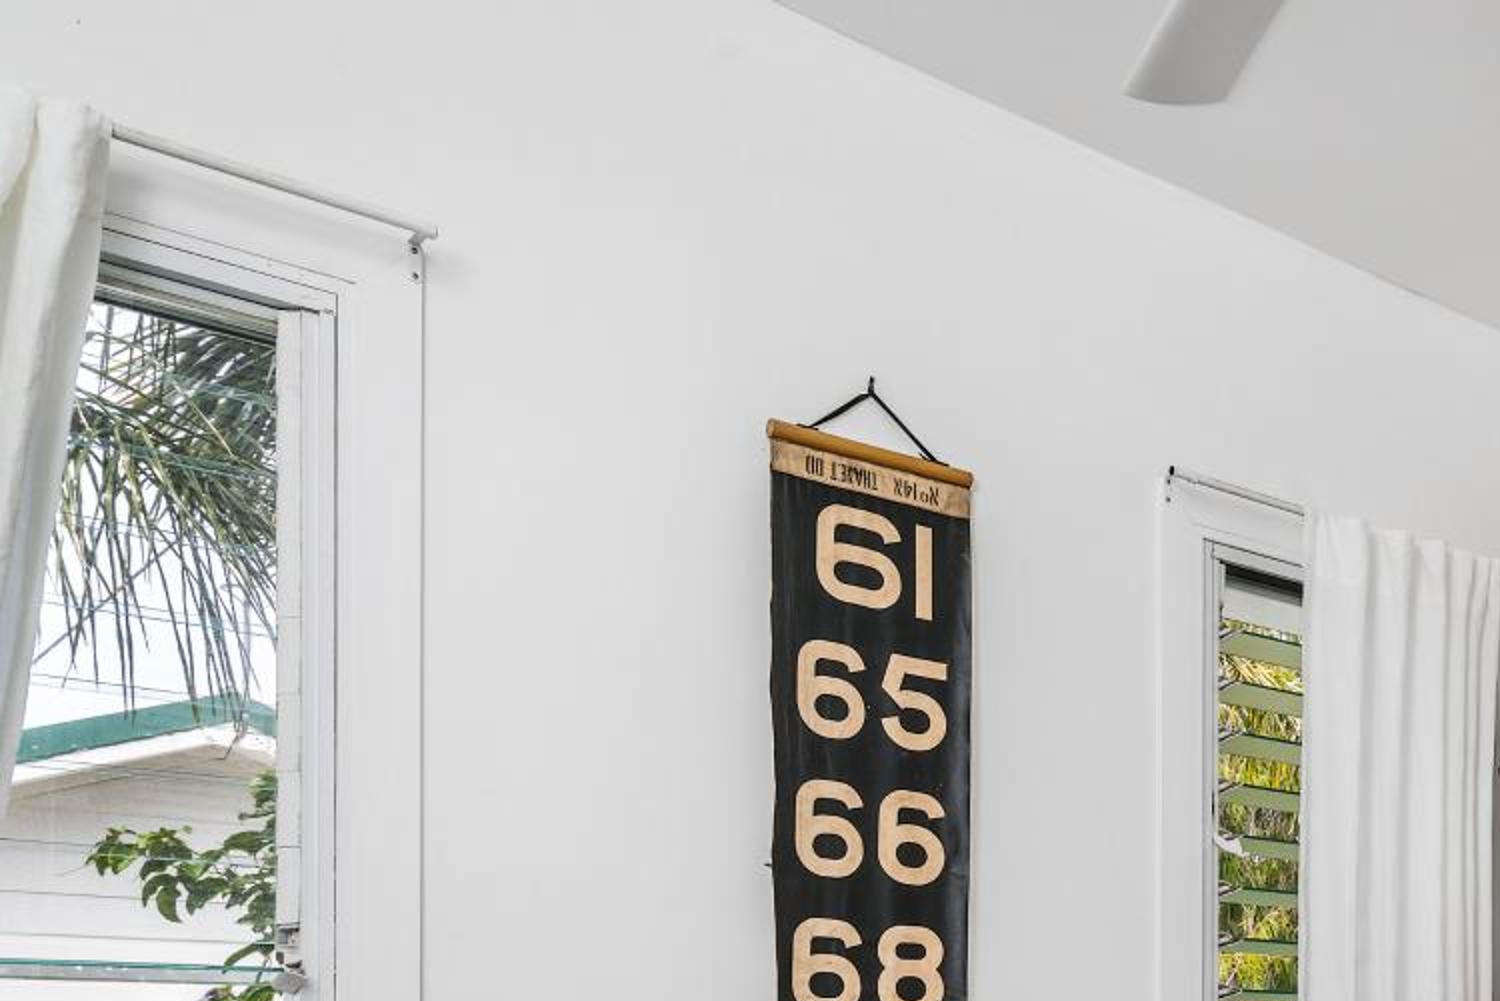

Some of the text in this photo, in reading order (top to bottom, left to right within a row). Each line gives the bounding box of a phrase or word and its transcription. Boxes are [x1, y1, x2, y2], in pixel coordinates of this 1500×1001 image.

[816, 504, 933, 621] 61
[797, 639, 948, 751] 65
[795, 779, 945, 886] 66
